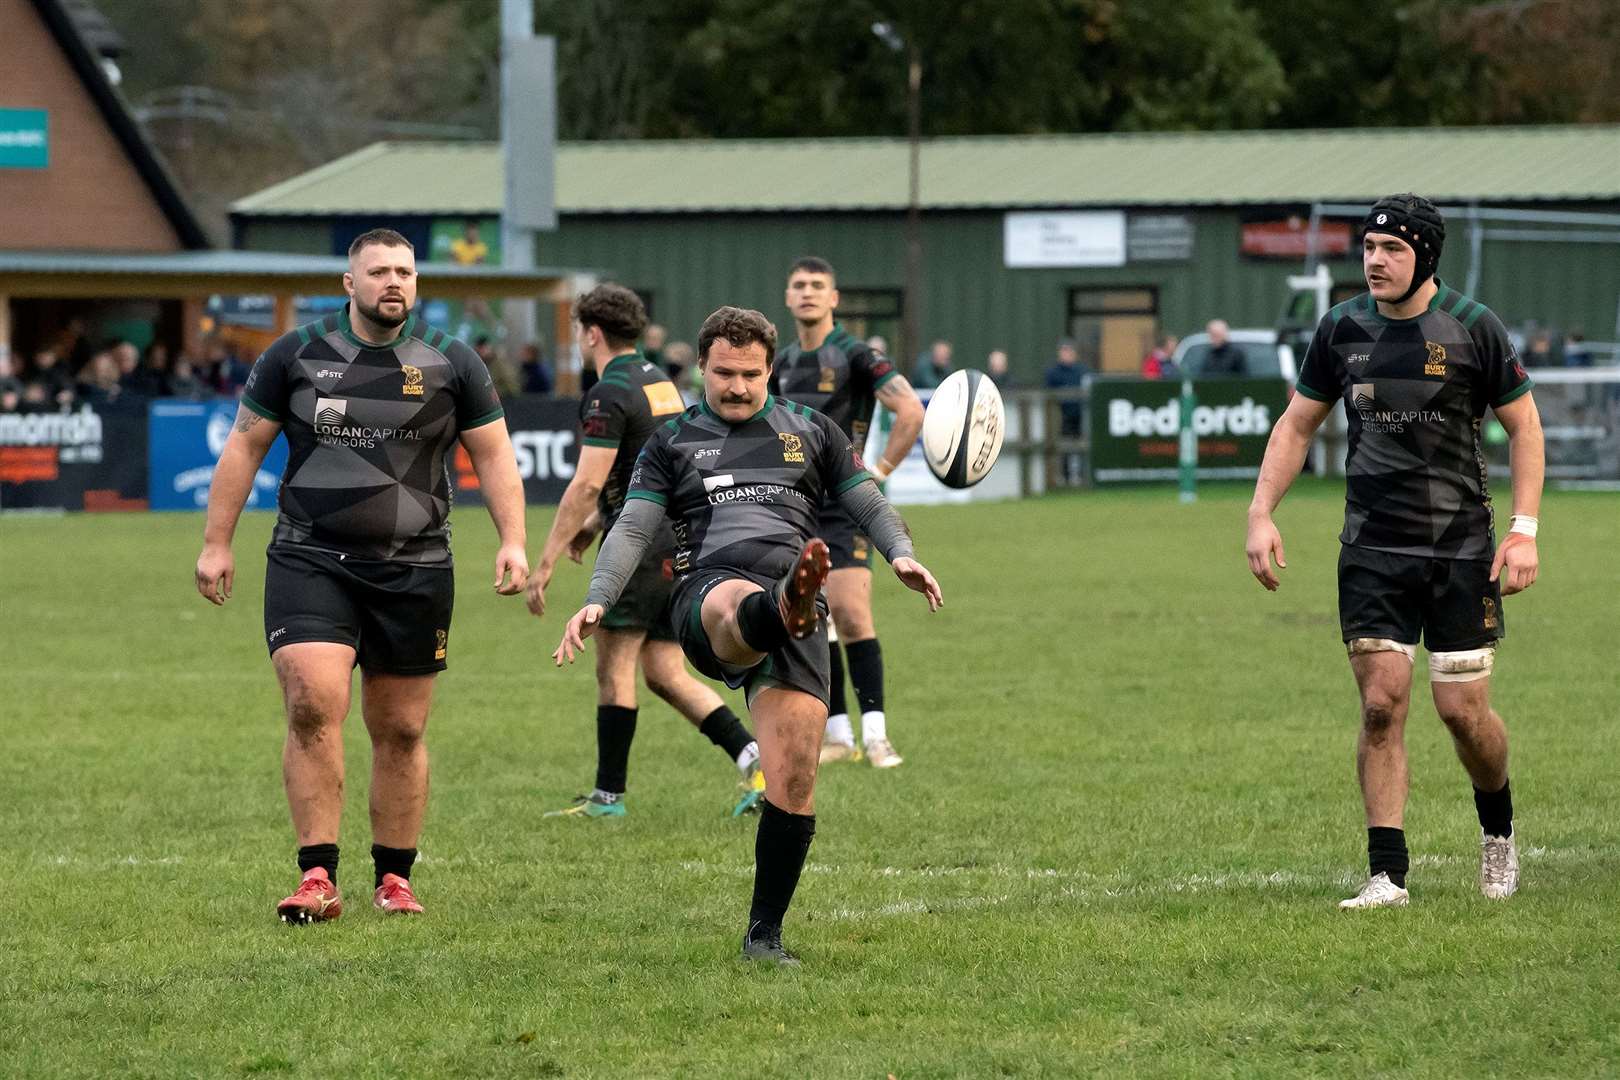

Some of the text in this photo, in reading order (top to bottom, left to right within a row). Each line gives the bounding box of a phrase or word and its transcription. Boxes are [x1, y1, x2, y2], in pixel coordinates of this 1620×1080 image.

[1109, 397, 1270, 436] Bedords
[314, 424, 422, 440] LOGANCAPITAL
[511, 429, 577, 480] STC
[275, 628, 286, 637] STC
